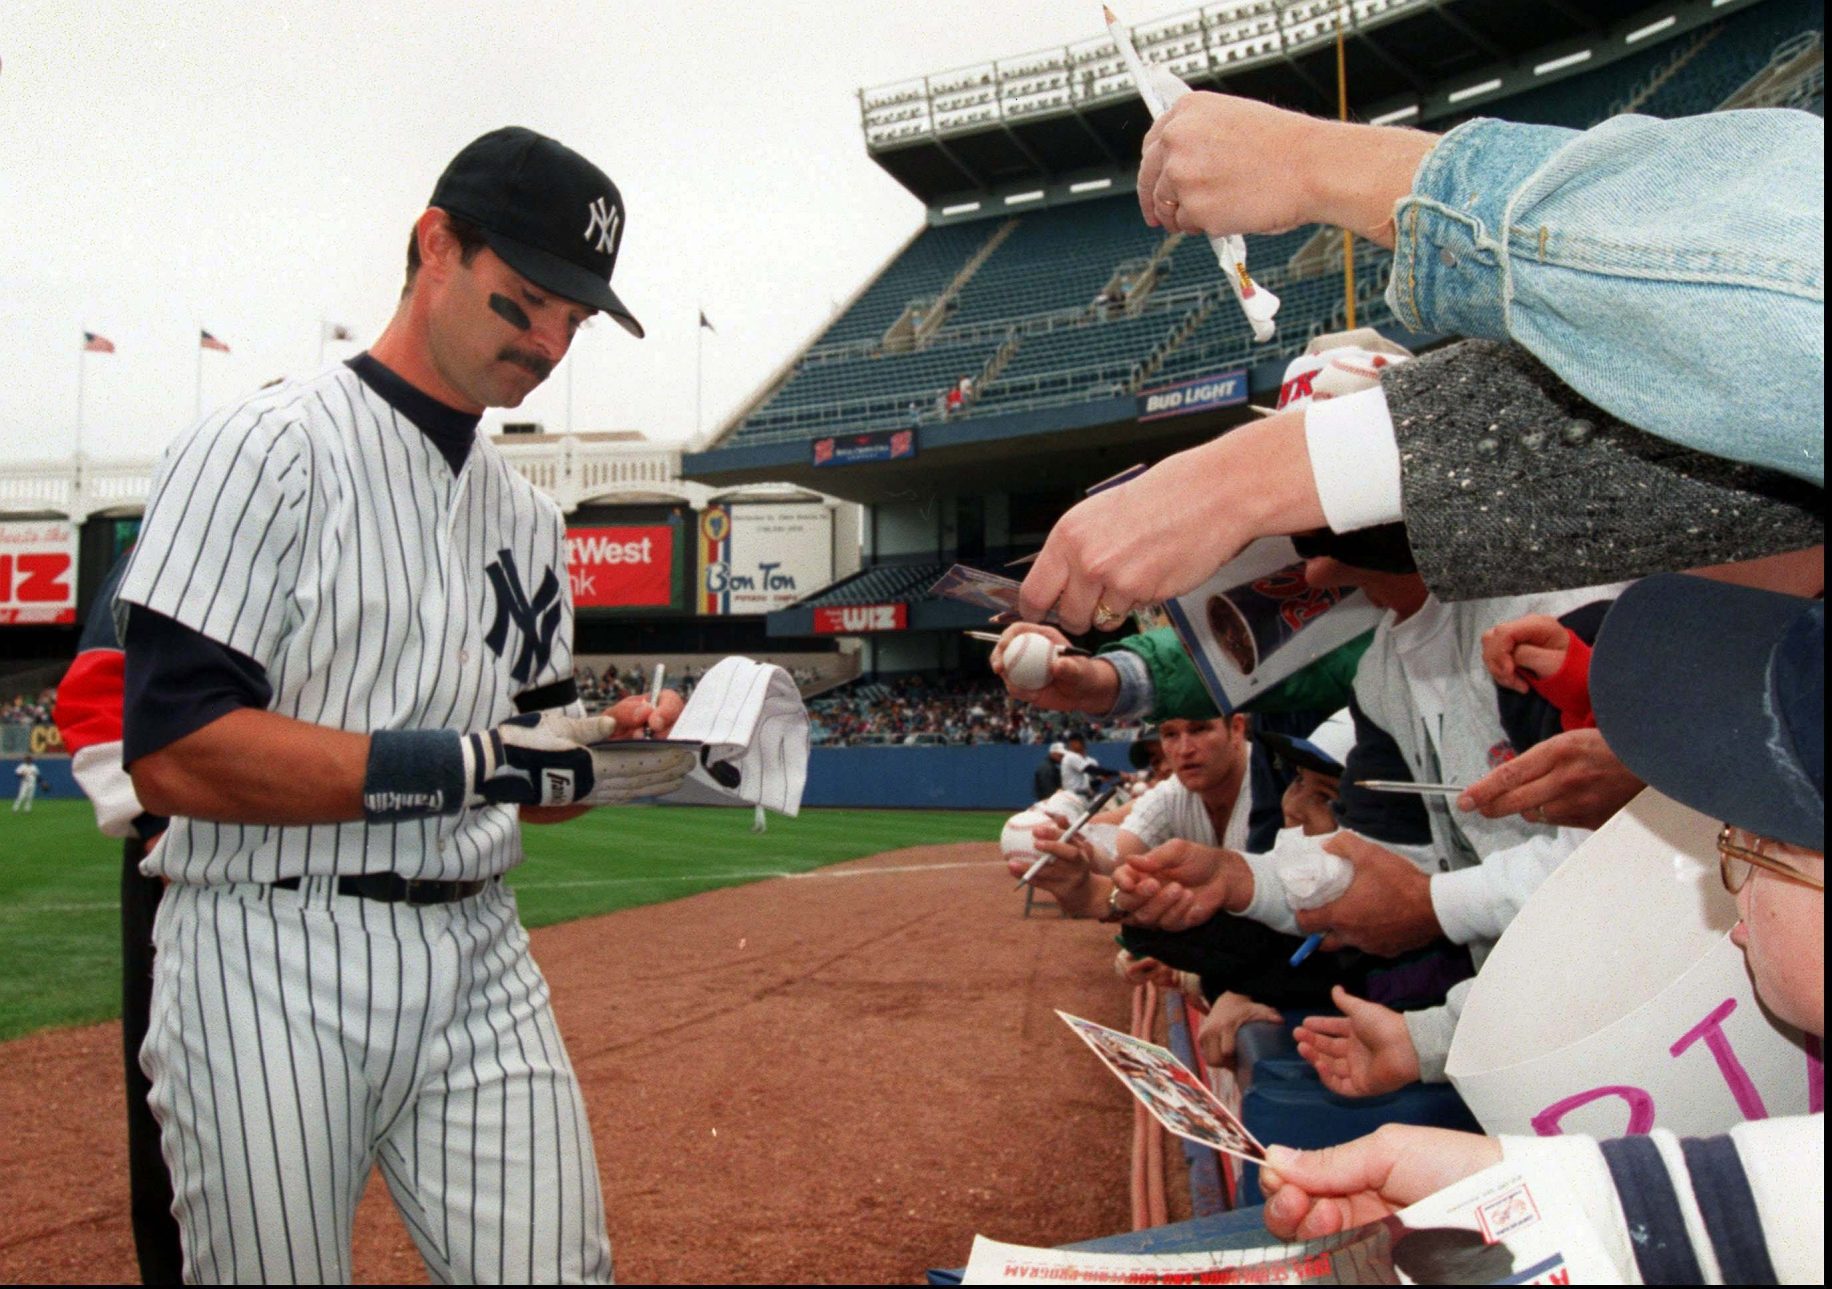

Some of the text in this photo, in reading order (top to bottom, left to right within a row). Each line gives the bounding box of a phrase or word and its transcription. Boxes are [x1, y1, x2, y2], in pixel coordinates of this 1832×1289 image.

[583, 196, 620, 254] NY
[1146, 379, 1237, 413] BUD LIGHT
[565, 535, 653, 565] tWest
[0, 553, 71, 602] IZ
[569, 568, 597, 596] nk
[705, 561, 797, 592] Bon Ton
[484, 548, 562, 684] NY
[842, 605, 897, 632] WIZ
[1004, 1264, 1080, 1281] PROGRAM
